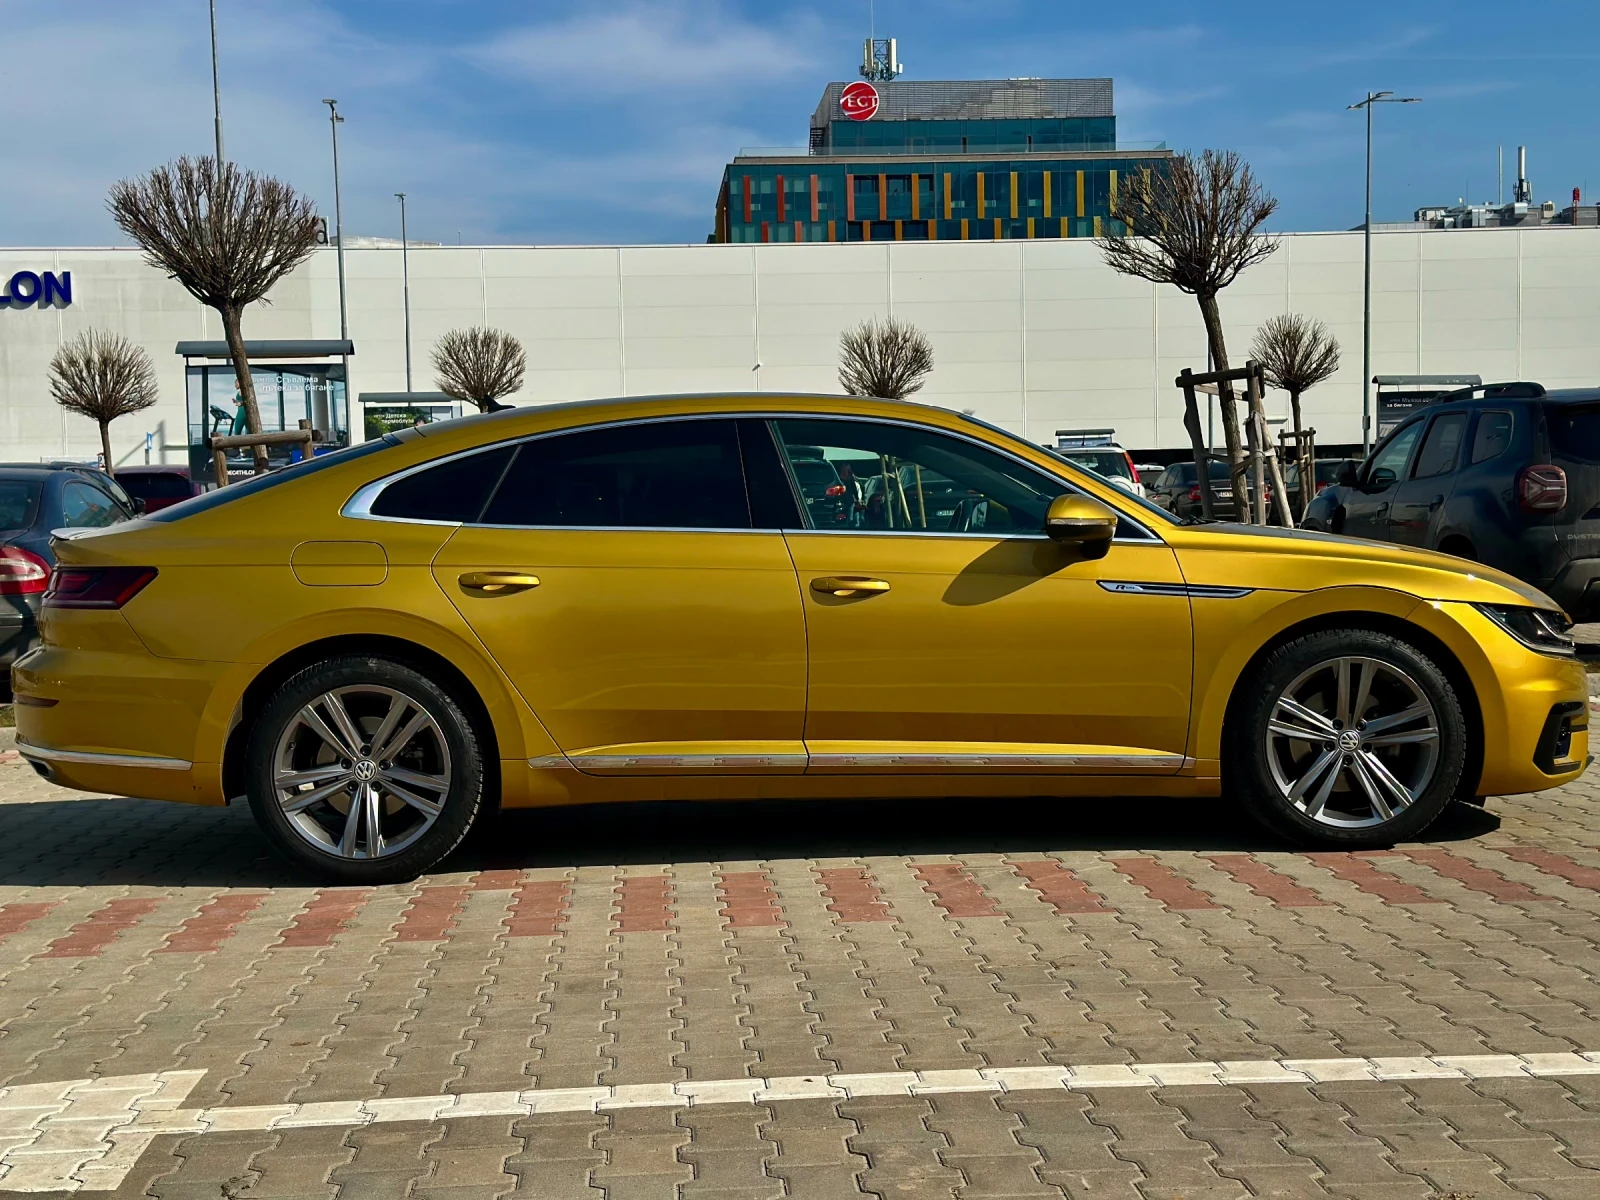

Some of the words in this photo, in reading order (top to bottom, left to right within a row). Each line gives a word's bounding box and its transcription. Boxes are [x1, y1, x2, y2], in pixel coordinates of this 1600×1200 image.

[847, 95, 878, 107] EGT
[276, 376, 318, 384] Сгъваема
[262, 384, 292, 392] пътека
[305, 383, 334, 391] бягане
